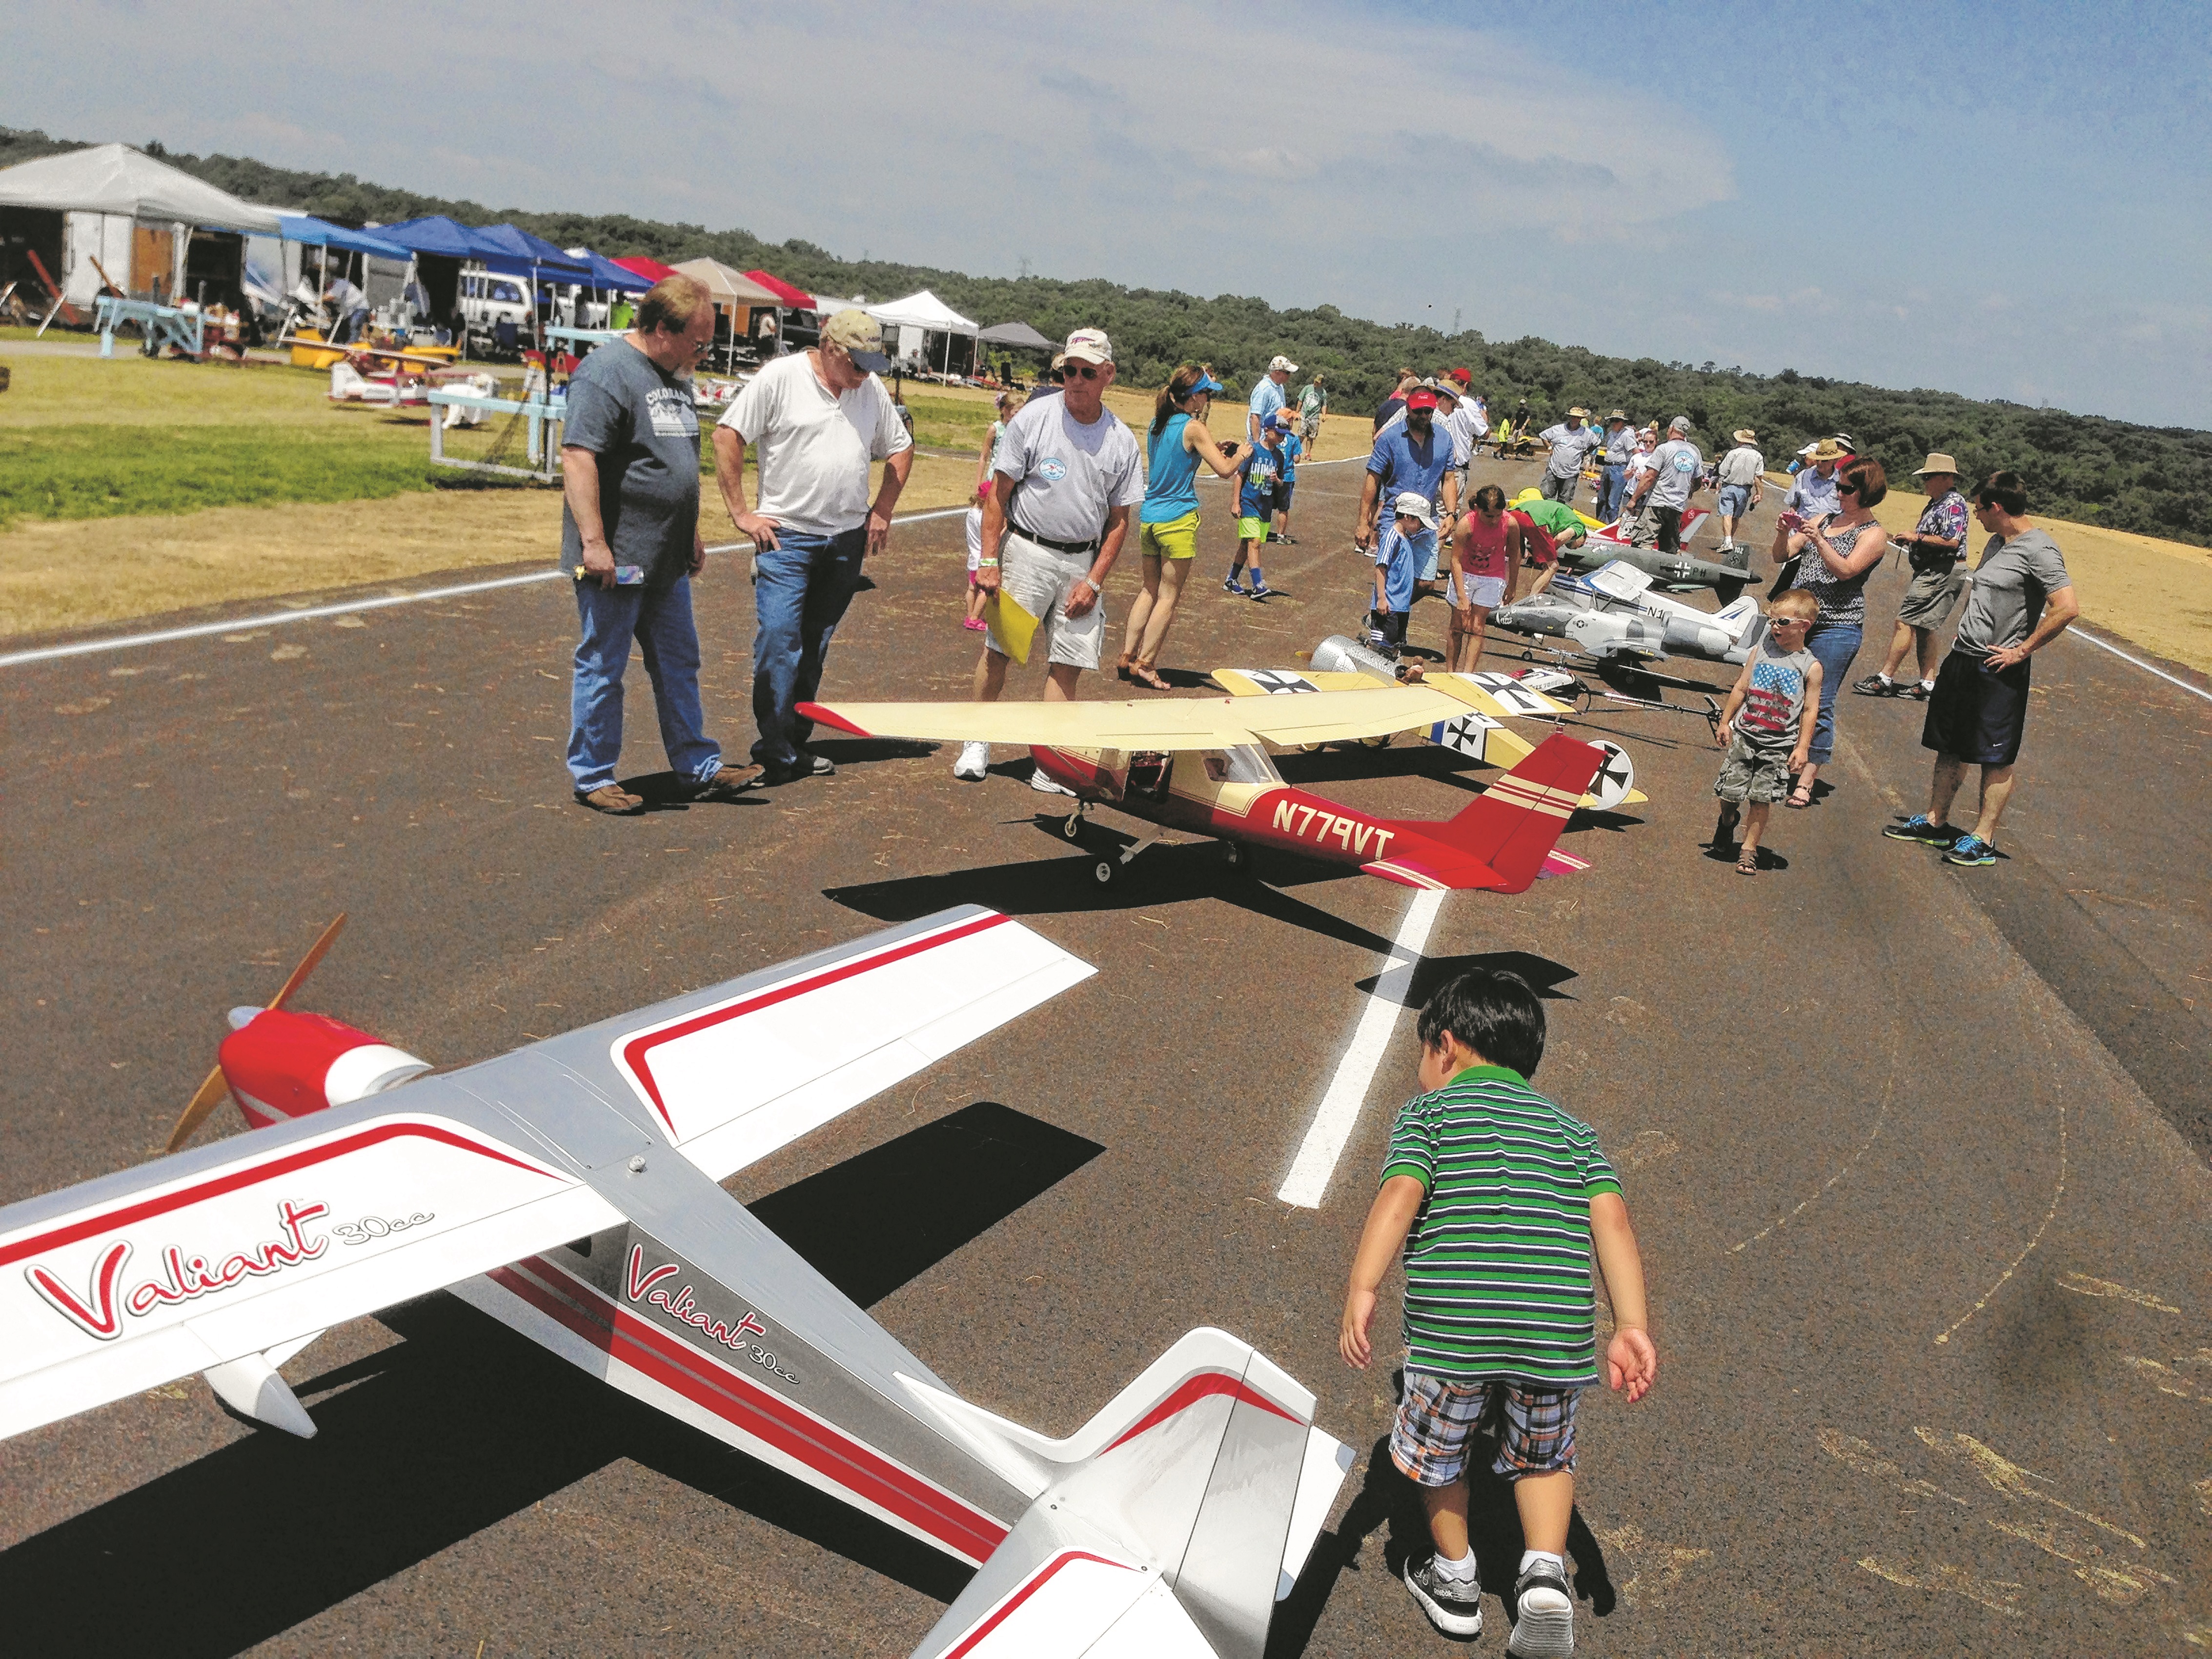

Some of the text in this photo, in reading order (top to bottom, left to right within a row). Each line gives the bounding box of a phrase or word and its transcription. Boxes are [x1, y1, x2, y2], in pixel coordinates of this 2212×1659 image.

[1734, 546, 1744, 554] 102
[1647, 606, 1665, 622] N1
[1273, 799, 1395, 860] N779VT
[25, 1198, 435, 1340] Valiant 30cc
[627, 1243, 800, 1385] Valiant 30cc
